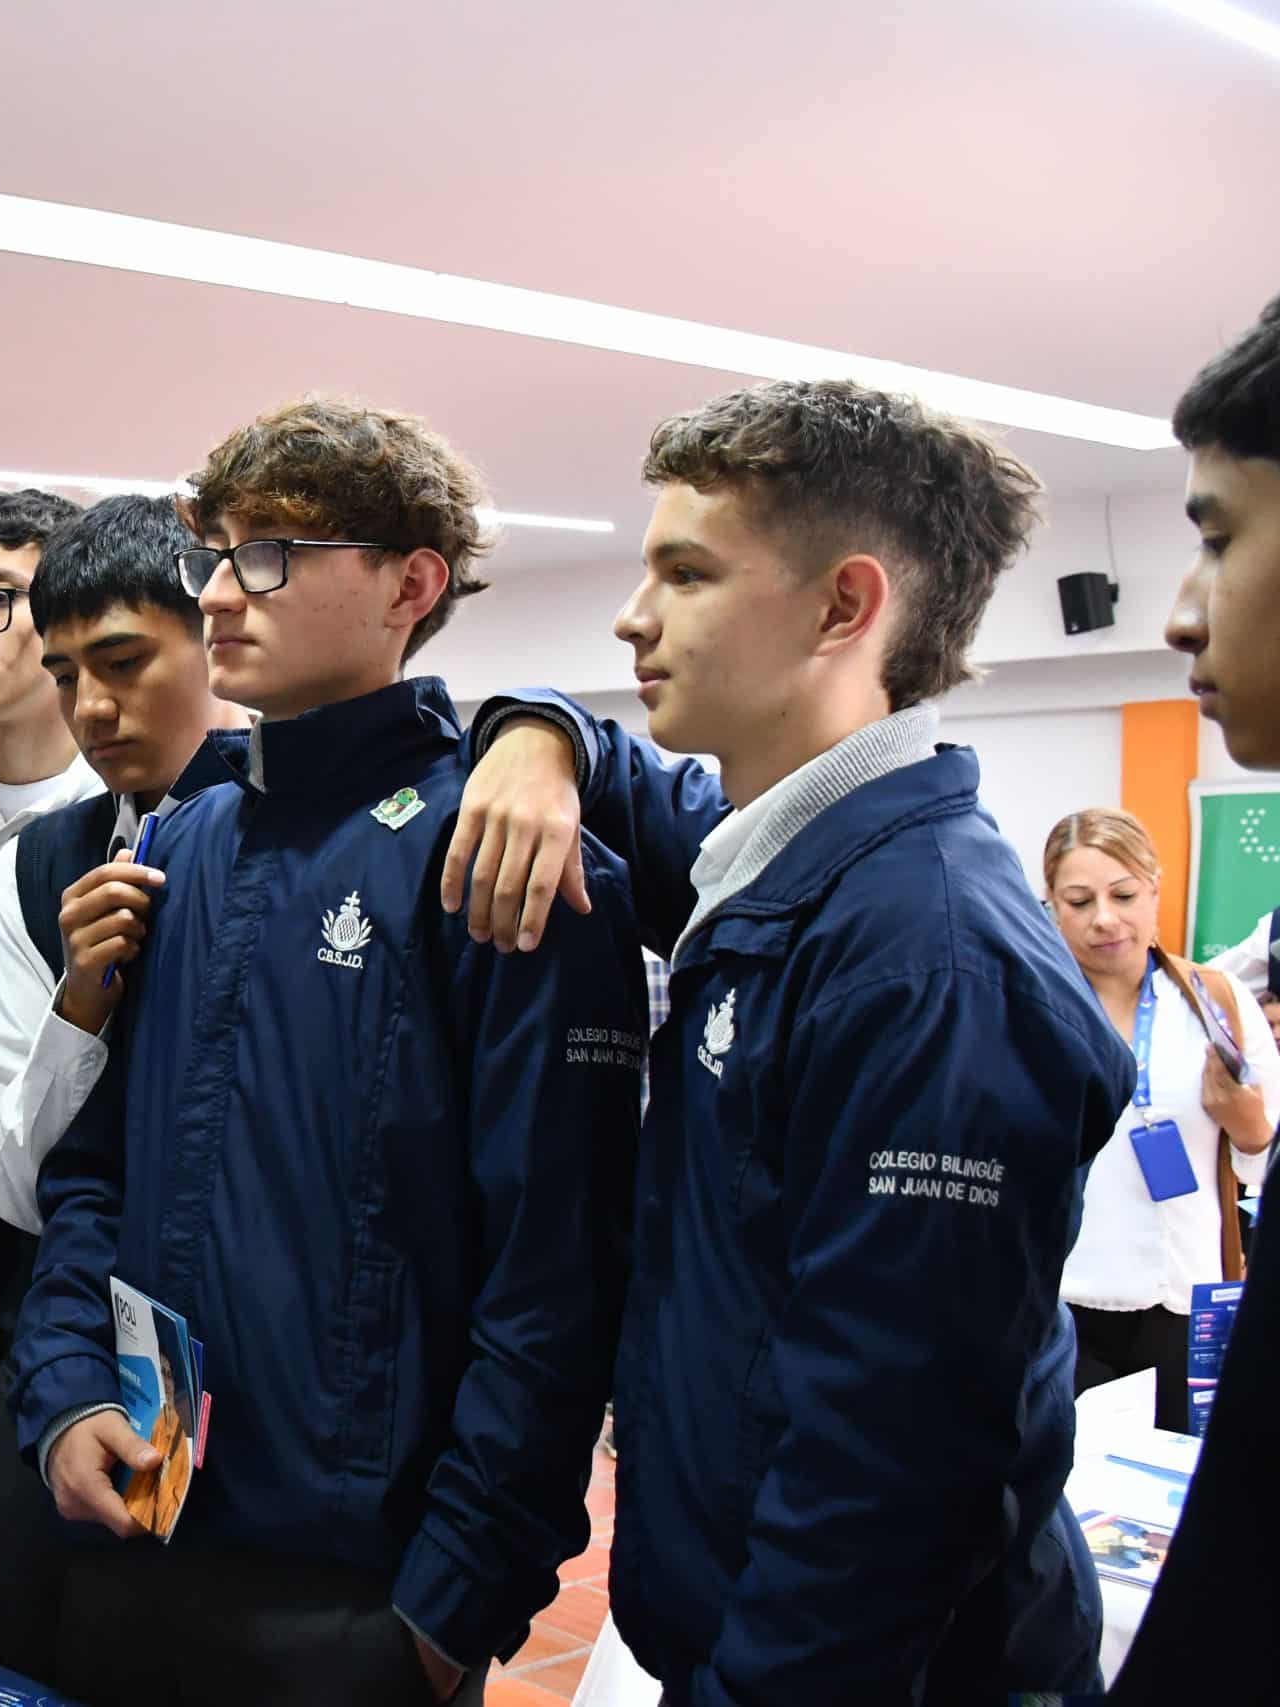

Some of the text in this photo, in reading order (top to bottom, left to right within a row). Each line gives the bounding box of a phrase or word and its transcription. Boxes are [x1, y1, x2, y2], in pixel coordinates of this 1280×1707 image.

[566, 1048, 589, 1063] SAN
[870, 1151, 1005, 1182] COLEGIO BILINGÜE
[869, 1176, 1000, 1207] SAN JUAN DE DIOS
